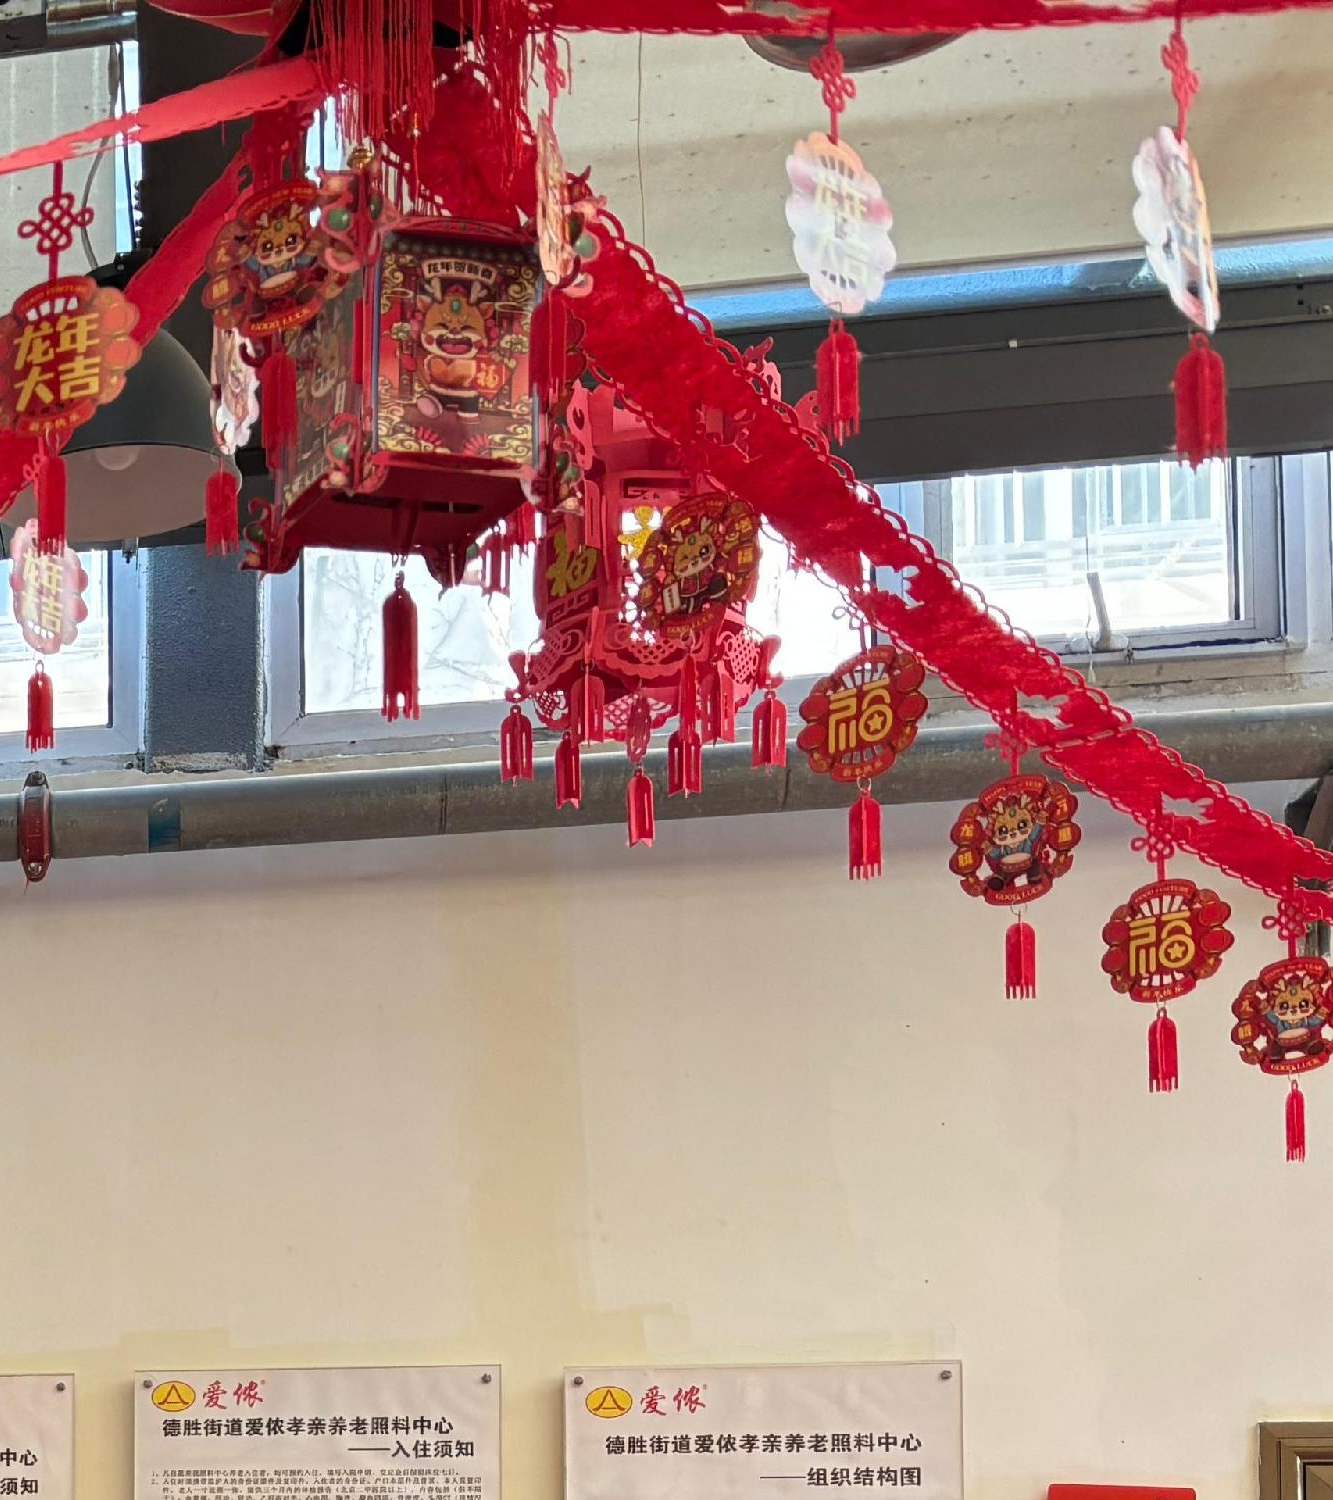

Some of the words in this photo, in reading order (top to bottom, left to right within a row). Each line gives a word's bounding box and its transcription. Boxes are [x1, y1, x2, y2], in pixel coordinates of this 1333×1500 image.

[13, 313, 101, 371] 龙年
[13, 356, 102, 413] 大吉
[828, 675, 894, 754] 福
[1128, 910, 1196, 977] 福
[202, 1379, 264, 1410] 爱侬
[639, 1384, 707, 1416] 爱侬
[162, 1416, 454, 1438] 德胜街道爱侬孝亲养老照料中心
[604, 1432, 922, 1456] 德胜街道爱侬孝亲养老照料中心
